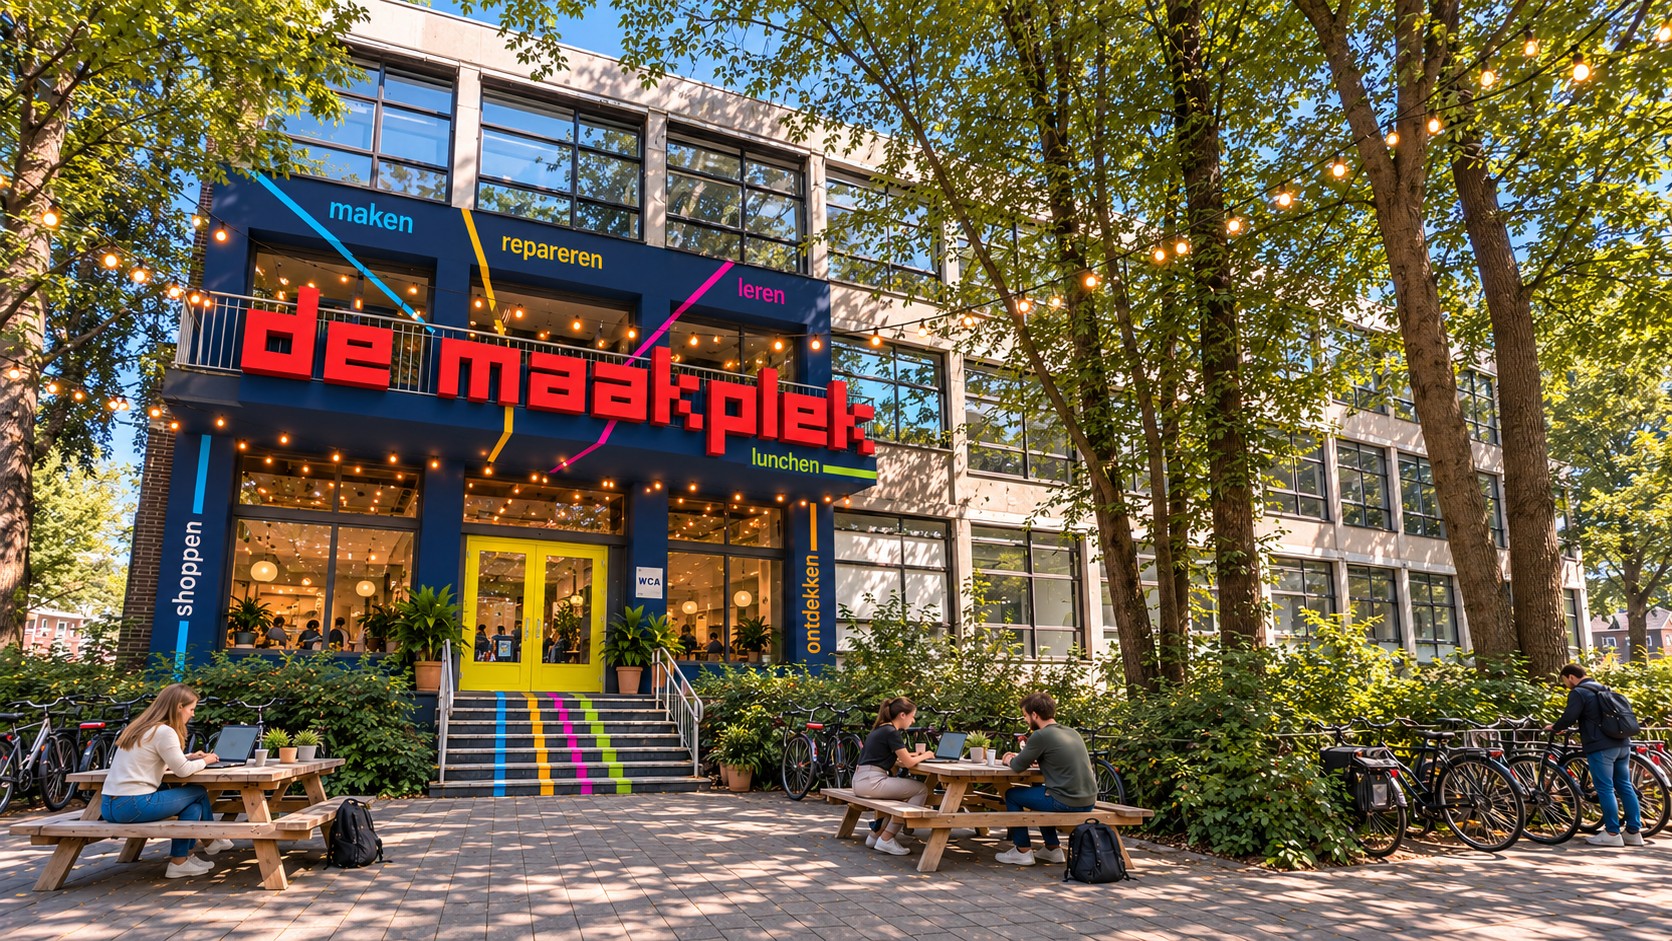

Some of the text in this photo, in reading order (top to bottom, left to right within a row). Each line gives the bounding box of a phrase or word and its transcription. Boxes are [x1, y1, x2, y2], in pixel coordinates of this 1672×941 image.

[329, 200, 413, 234] maken
[501, 235, 604, 271] repareren
[738, 276, 785, 305] leren
[240, 285, 876, 457] de maakplek
[752, 448, 820, 474] lunchen
[171, 520, 203, 617] shoppen
[638, 577, 661, 586] WCA
[801, 555, 821, 654] ontdekken
